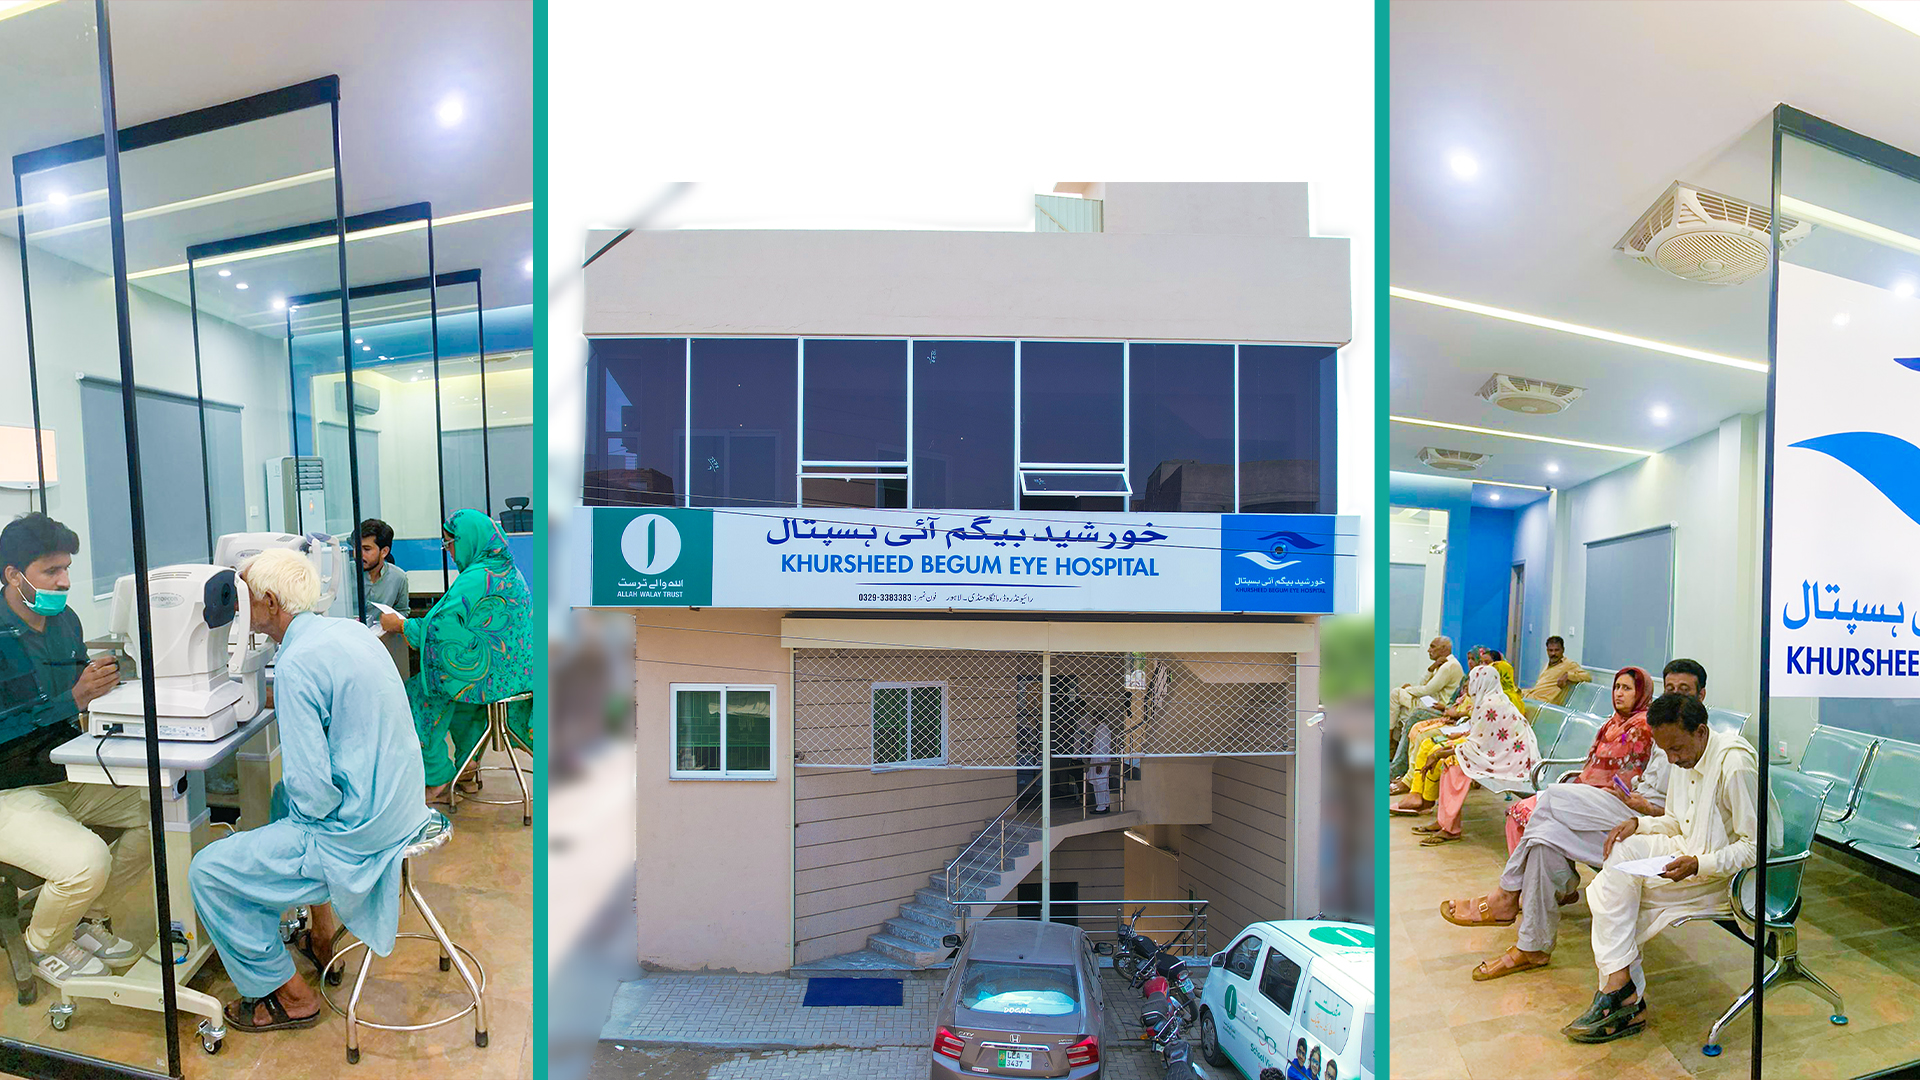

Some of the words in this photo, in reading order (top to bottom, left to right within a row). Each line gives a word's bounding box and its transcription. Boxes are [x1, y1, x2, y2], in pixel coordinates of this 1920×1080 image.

[766, 517, 878, 547] ہسپتال
[885, 516, 940, 546] آئی
[946, 516, 1026, 549] بیگم
[1033, 522, 1168, 549] خورشید
[782, 554, 913, 573] KHURSHEED
[921, 554, 1002, 574] BEGUM
[1009, 556, 1047, 575] EYE
[1056, 557, 1159, 576] HOSPITAL
[1275, 576, 1294, 587] بیگم
[1295, 577, 1326, 587] خورشید
[858, 593, 912, 602] 0329-3383383
[1783, 579, 1905, 638] ہسپتال
[1787, 646, 1920, 676] KHURSHEE
[1003, 1006, 1032, 1014] DOGAR
